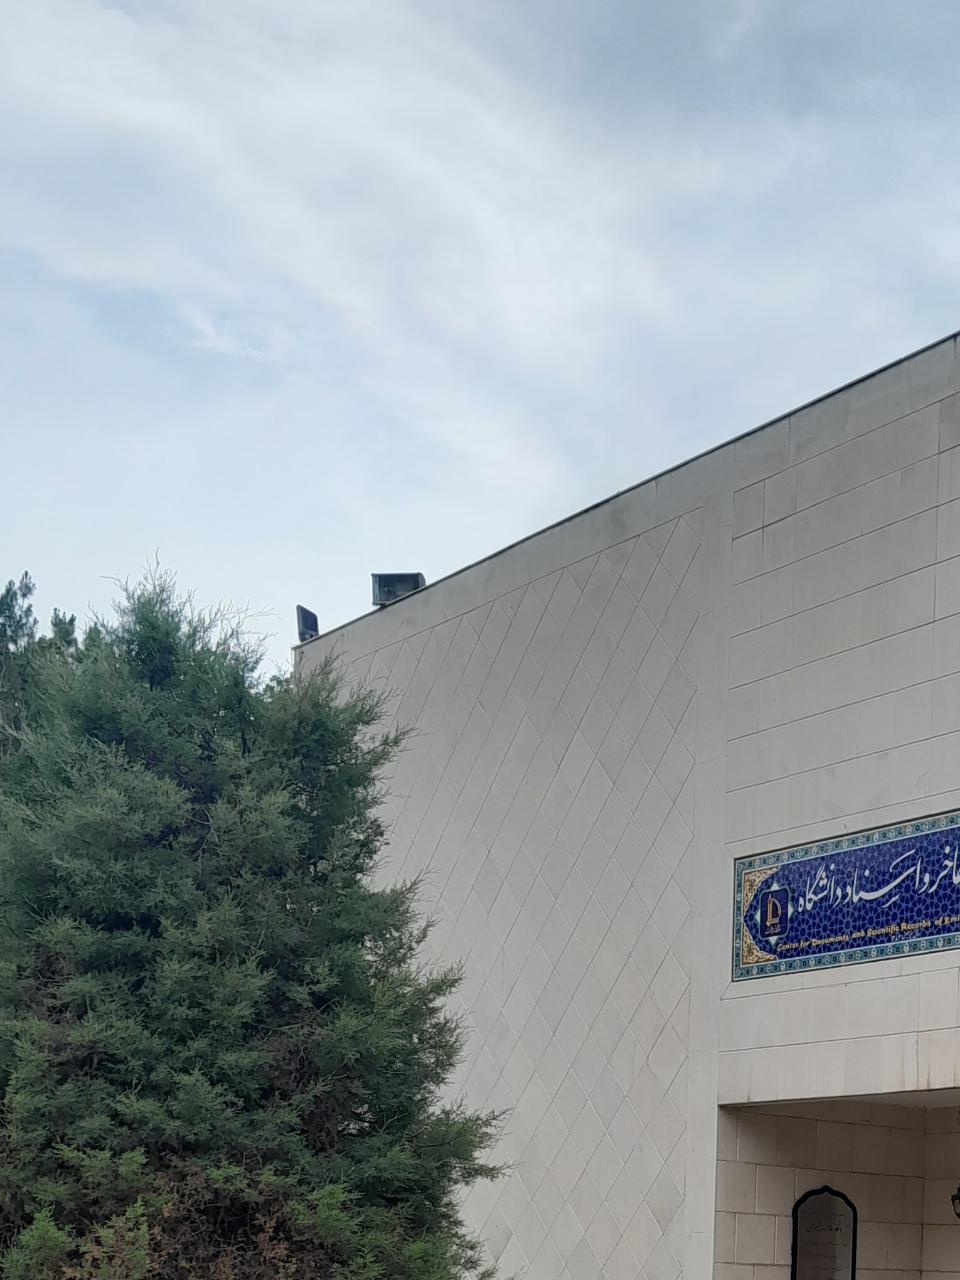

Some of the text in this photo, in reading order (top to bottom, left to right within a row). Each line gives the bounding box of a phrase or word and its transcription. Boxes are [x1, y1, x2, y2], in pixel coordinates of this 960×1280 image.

[798, 863, 842, 913] دانشگاه
[799, 939, 810, 949] for
[811, 934, 849, 947] Documents
[851, 929, 865, 939] and
[867, 924, 900, 937] Scientific
[900, 920, 931, 932] Records
[934, 917, 943, 929] of
